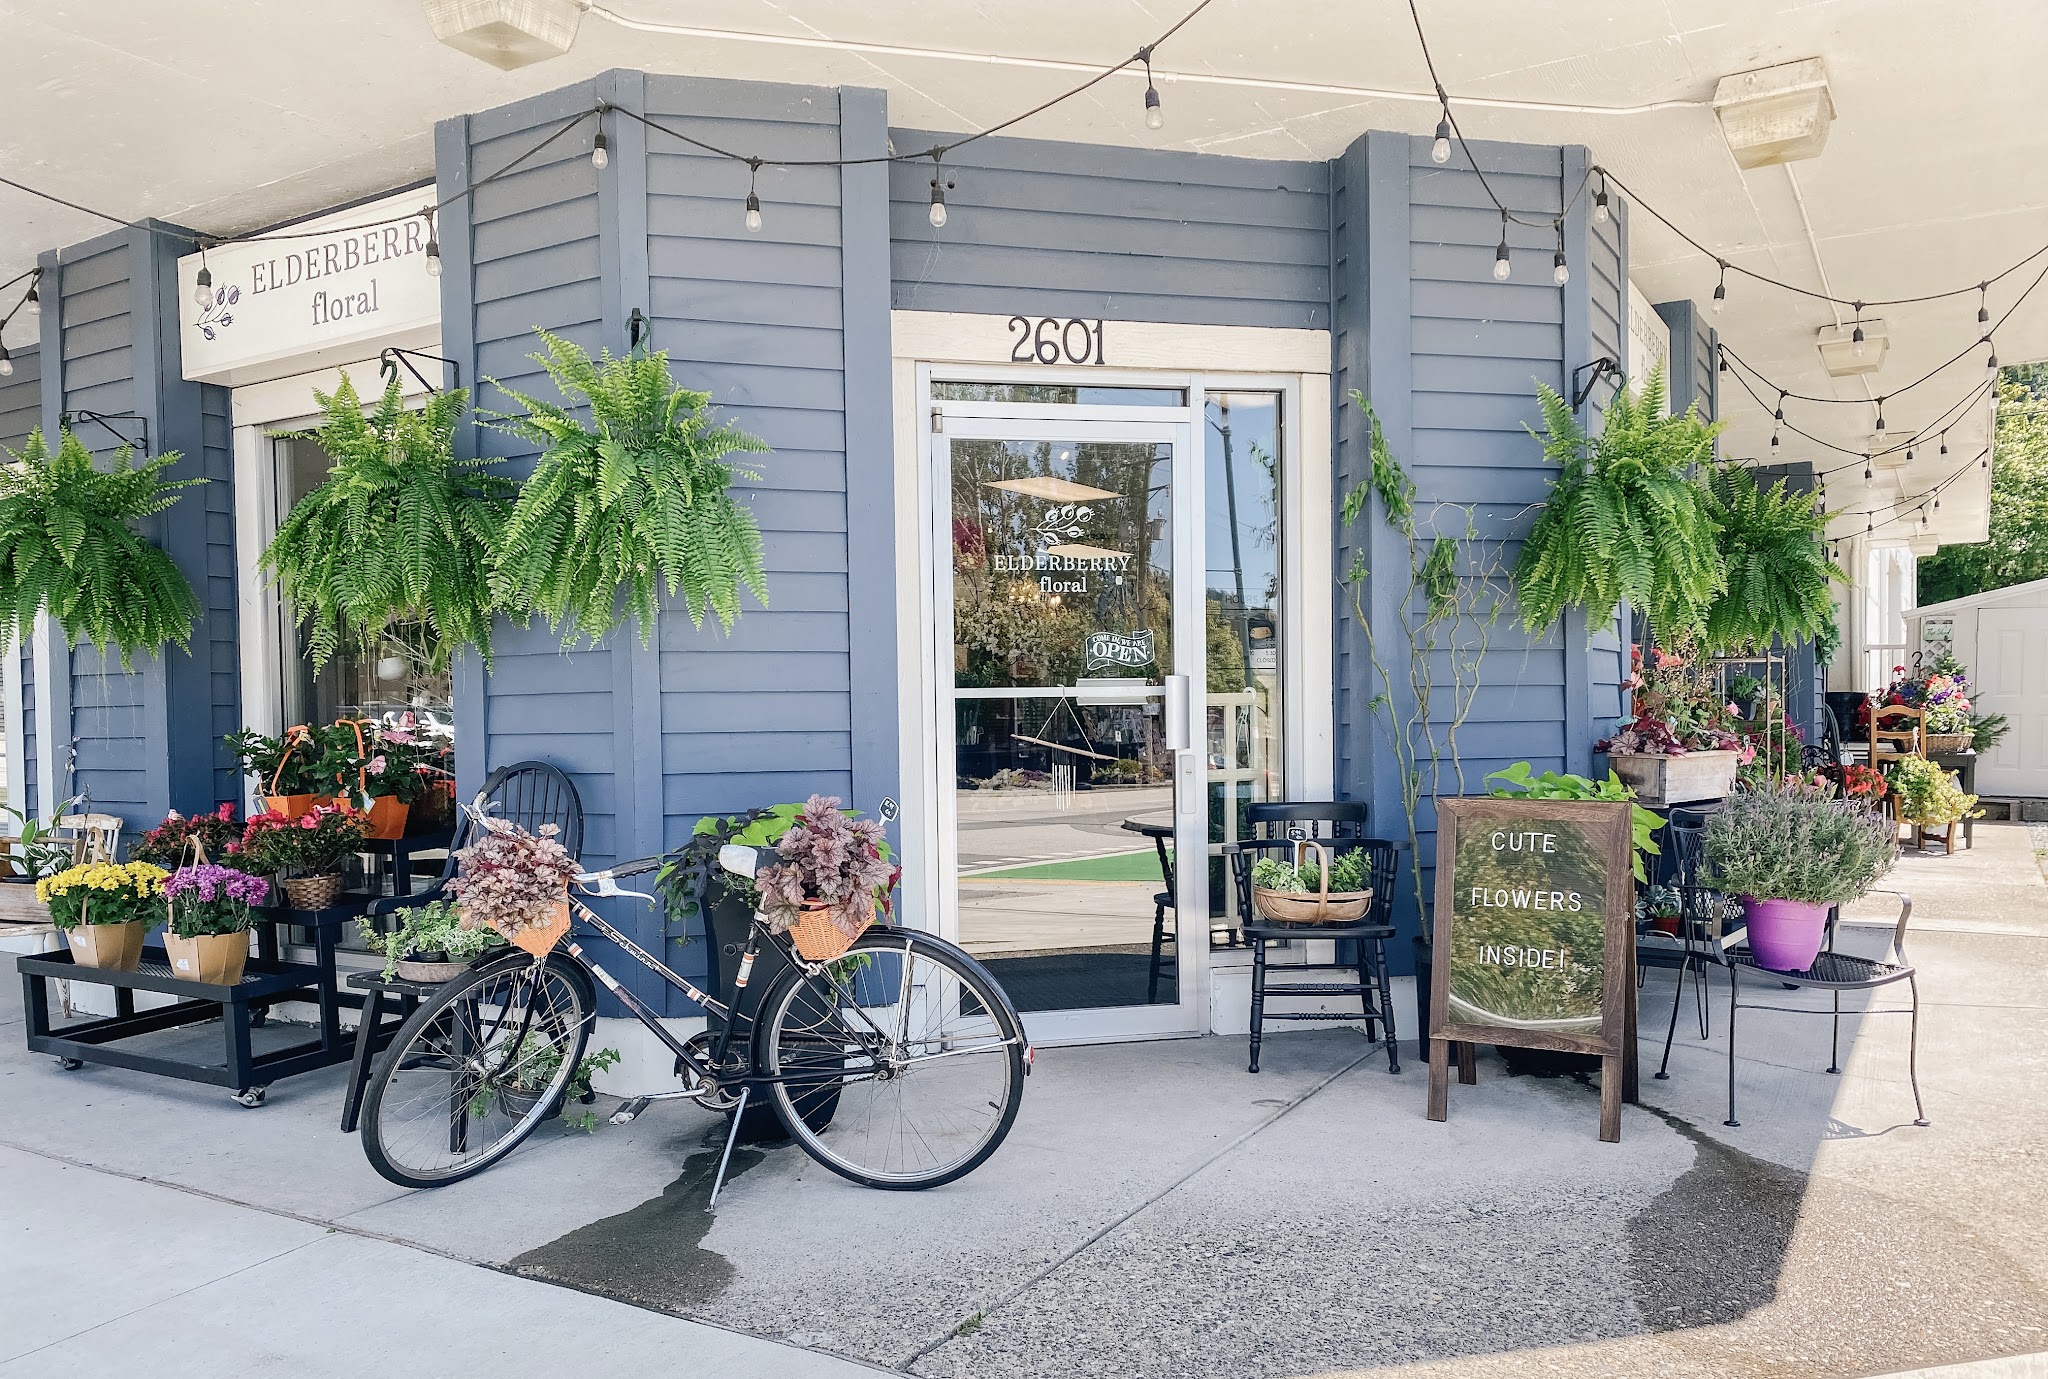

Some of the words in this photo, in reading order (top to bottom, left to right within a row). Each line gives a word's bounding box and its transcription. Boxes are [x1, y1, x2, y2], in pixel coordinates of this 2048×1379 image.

[311, 278, 380, 326] floral
[1008, 315, 1106, 365] 2601
[993, 554, 1132, 572] ELDERBERRY
[1039, 575, 1088, 593] floral
[1225, 594, 1258, 605] HOURS
[1092, 634, 1111, 643] COME
[1092, 641, 1149, 662] OPEN
[1491, 831, 1557, 854] CUTE
[1471, 887, 1583, 912] FLOWERS
[1478, 945, 1565, 974] INSIDE!
